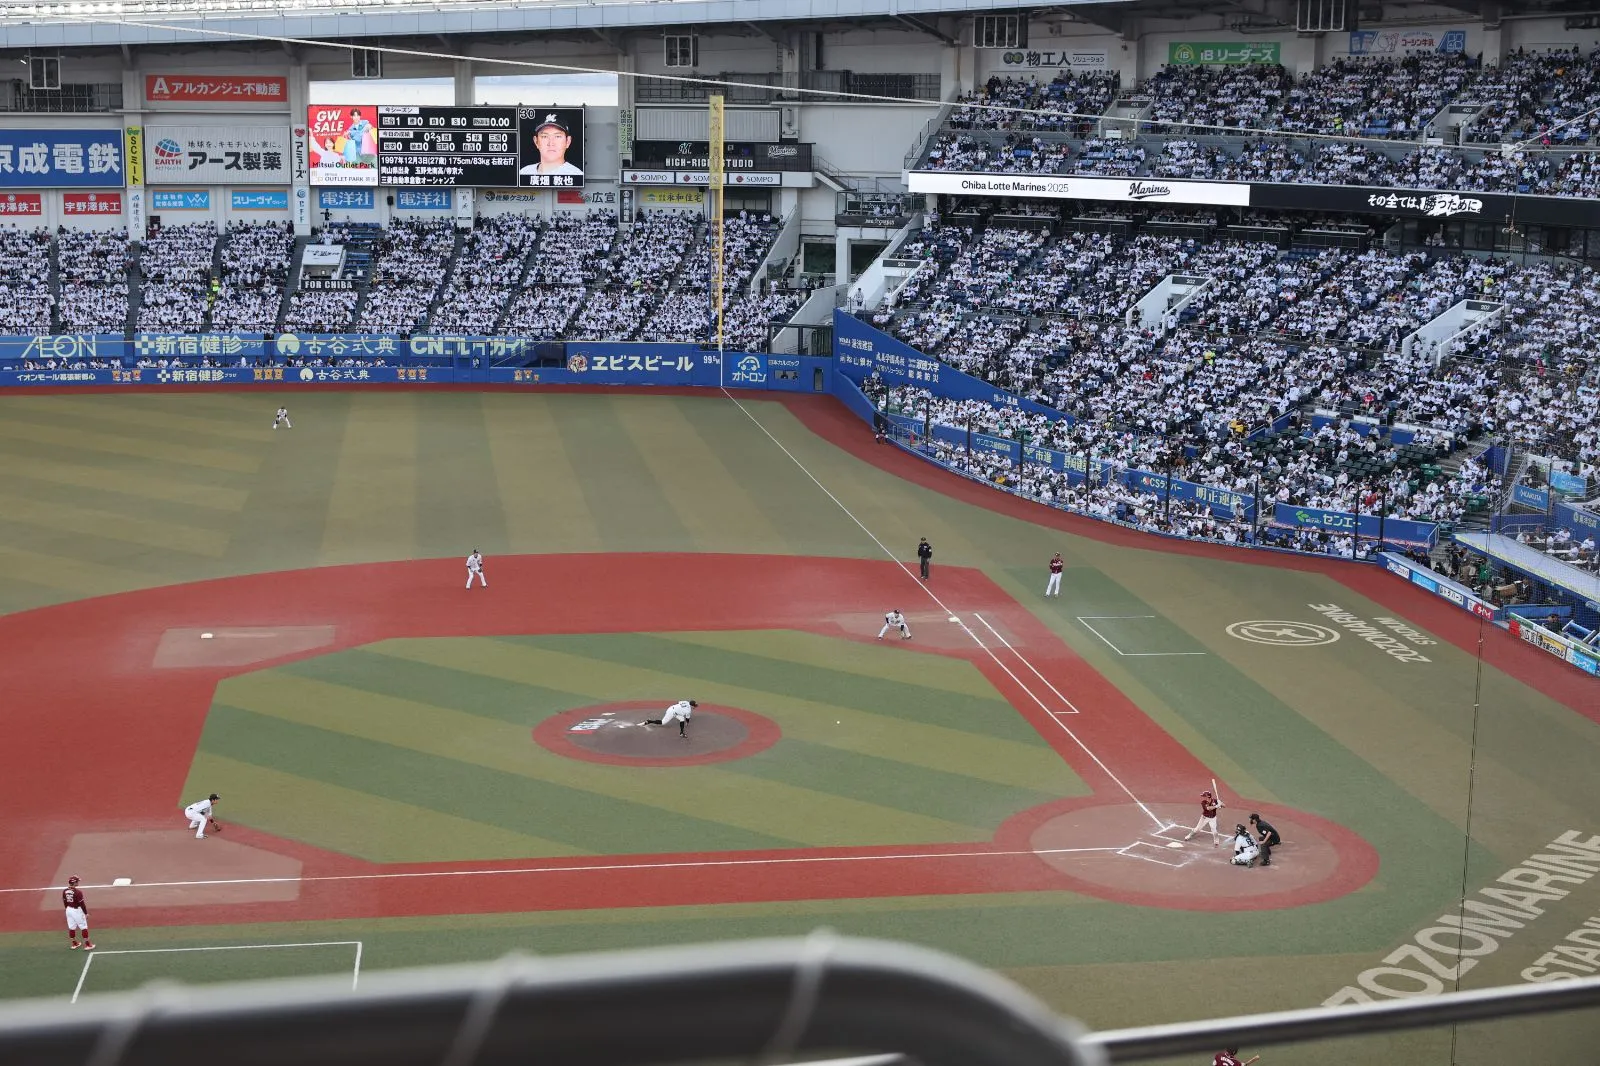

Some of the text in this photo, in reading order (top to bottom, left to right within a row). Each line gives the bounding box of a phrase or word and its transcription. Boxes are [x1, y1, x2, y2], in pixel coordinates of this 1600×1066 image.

[1026, 51, 1071, 66] 物工人
[171, 82, 280, 95] アルカンジュ不動産
[317, 110, 341, 121] GW
[520, 109, 535, 119] 30
[313, 121, 344, 132] SALE
[490, 118, 510, 126] 0.00
[130, 136, 139, 184] SCミート
[188, 152, 281, 170] アース製薬
[449, 157, 490, 166] 175cm/83kg
[666, 158, 709, 167] HIGH-RIG
[962, 181, 1069, 192] Chiba Lotte Marines 2025
[1128, 182, 1170, 200] Marines
[322, 192, 372, 206] 電洋社
[399, 192, 449, 206] 電洋社
[592, 192, 615, 203] 広宣
[304, 336, 398, 355] 古谷式典
[17, 373, 96, 381] イオンモール幕張新都心
[316, 368, 370, 380] 古谷式典
[732, 371, 766, 382] オトロン
[1306, 604, 1432, 662] ZOZOMARINE
[1372, 617, 1437, 645] STADIUM
